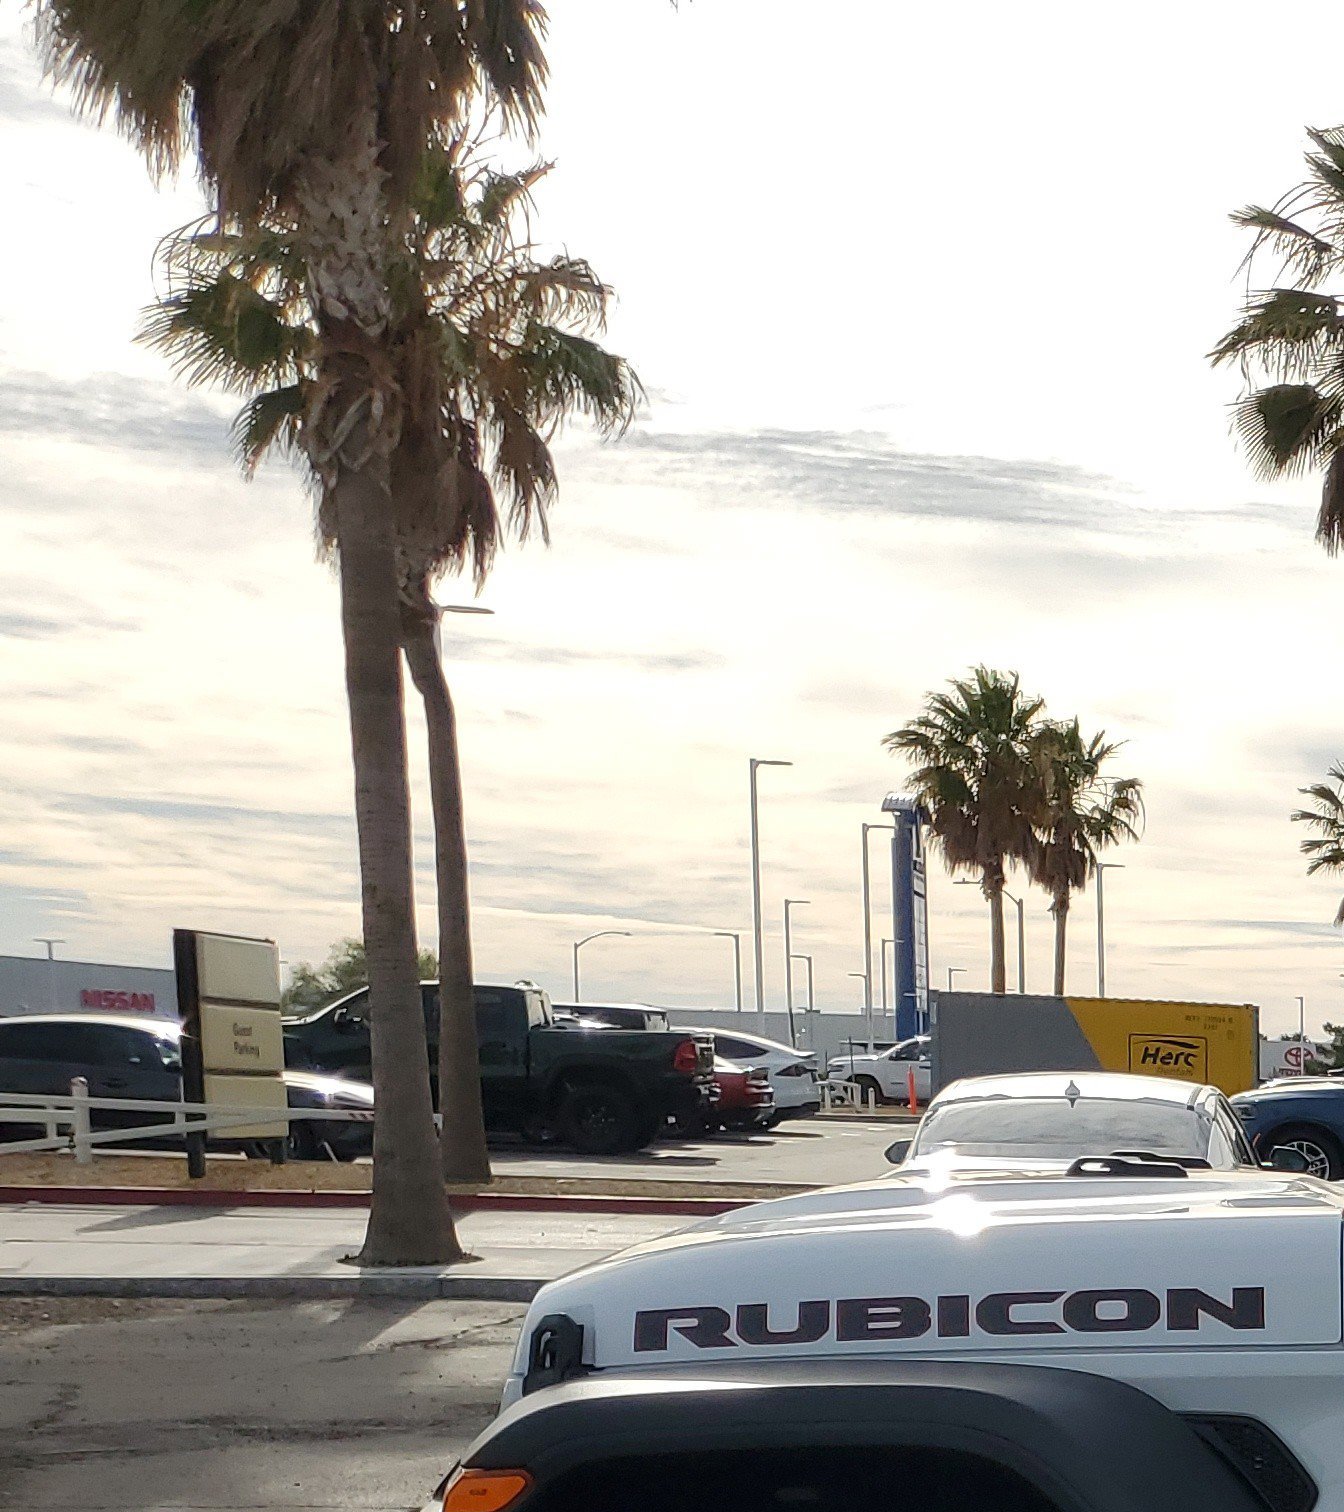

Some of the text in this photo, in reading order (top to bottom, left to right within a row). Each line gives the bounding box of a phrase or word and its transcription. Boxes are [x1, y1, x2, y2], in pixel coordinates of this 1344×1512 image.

[80, 989, 155, 1012] NISSAN
[1140, 1046, 1198, 1068] Herc
[633, 1286, 1266, 1352] RUBICON
